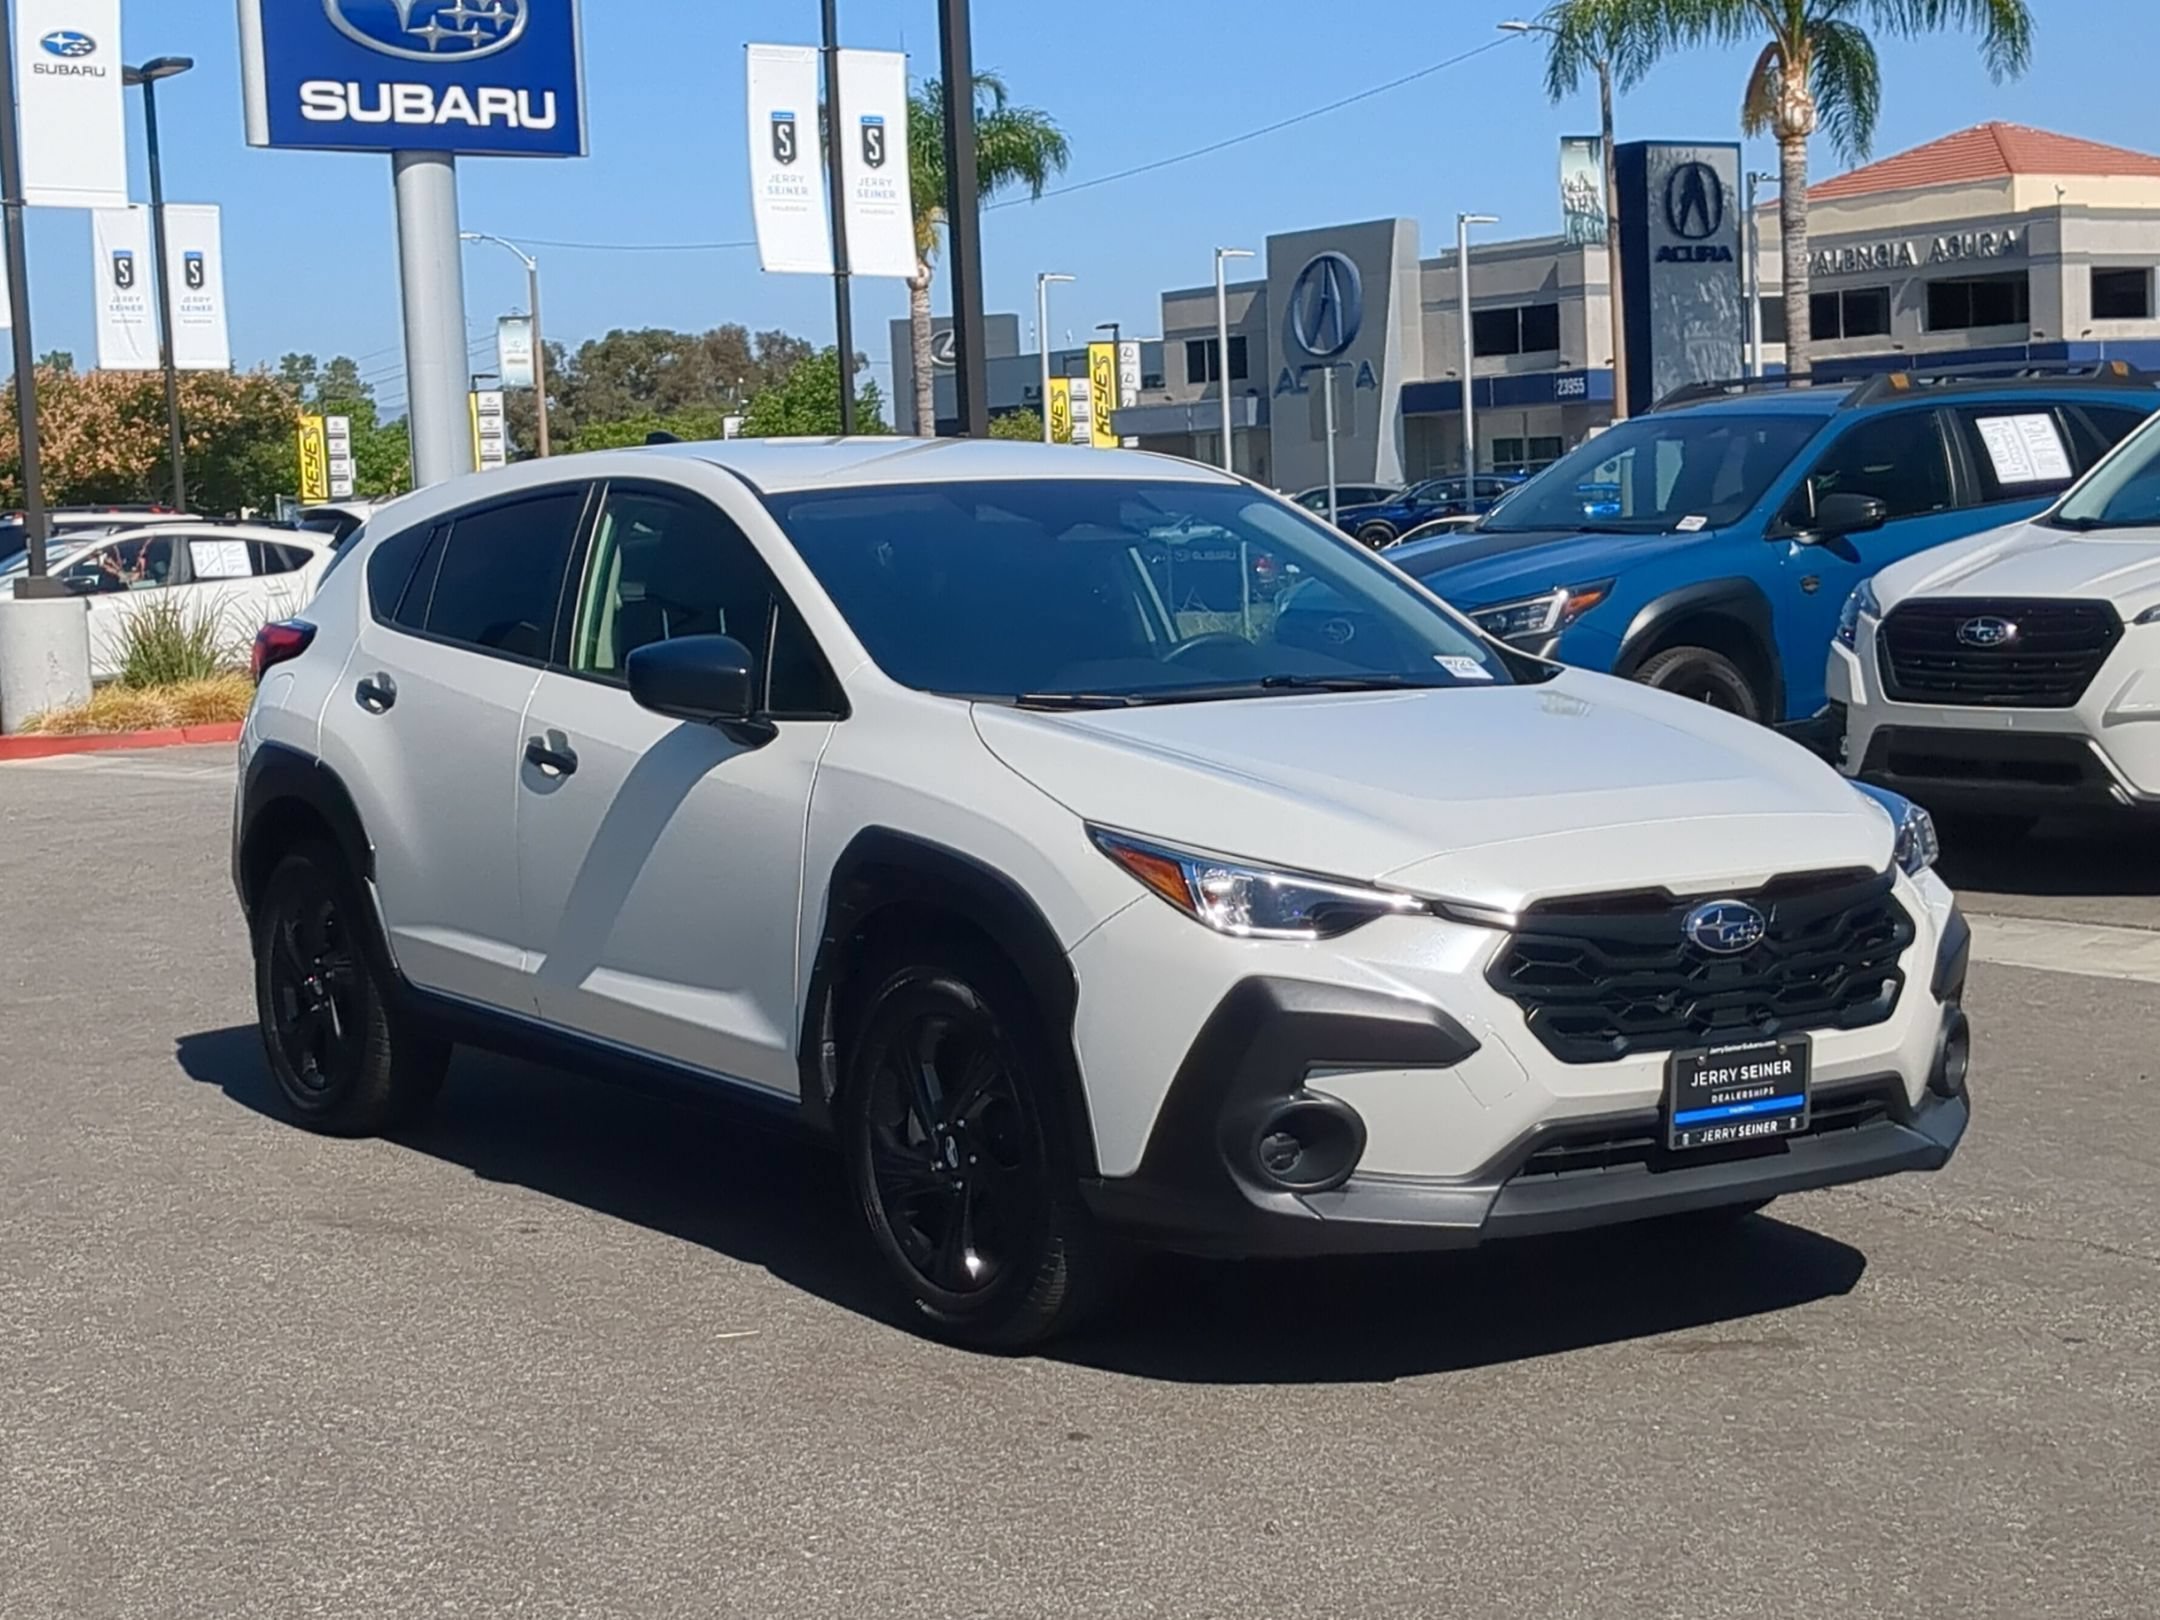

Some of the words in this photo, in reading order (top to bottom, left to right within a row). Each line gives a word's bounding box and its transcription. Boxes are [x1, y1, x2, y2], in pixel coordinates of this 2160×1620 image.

[33, 63, 106, 77] SUBARU
[299, 80, 556, 130] SUBARU
[769, 174, 805, 184] JERRY
[859, 177, 893, 188] JERRY
[767, 185, 809, 196] SEINER
[856, 188, 897, 199] SEINER
[1655, 245, 1734, 263] ACURA
[1928, 229, 2017, 264] ACURA
[1273, 359, 1379, 399] ACA
[1093, 351, 1111, 437] KEYES
[303, 424, 320, 498] KEYES
[1690, 1067, 1738, 1087] JERRY
[1740, 1060, 1792, 1080] SEINER
[1711, 1086, 1775, 1104] DEALERSHIPS
[1700, 1128, 1737, 1143] JERRY
[1738, 1121, 1778, 1137] SEINER
